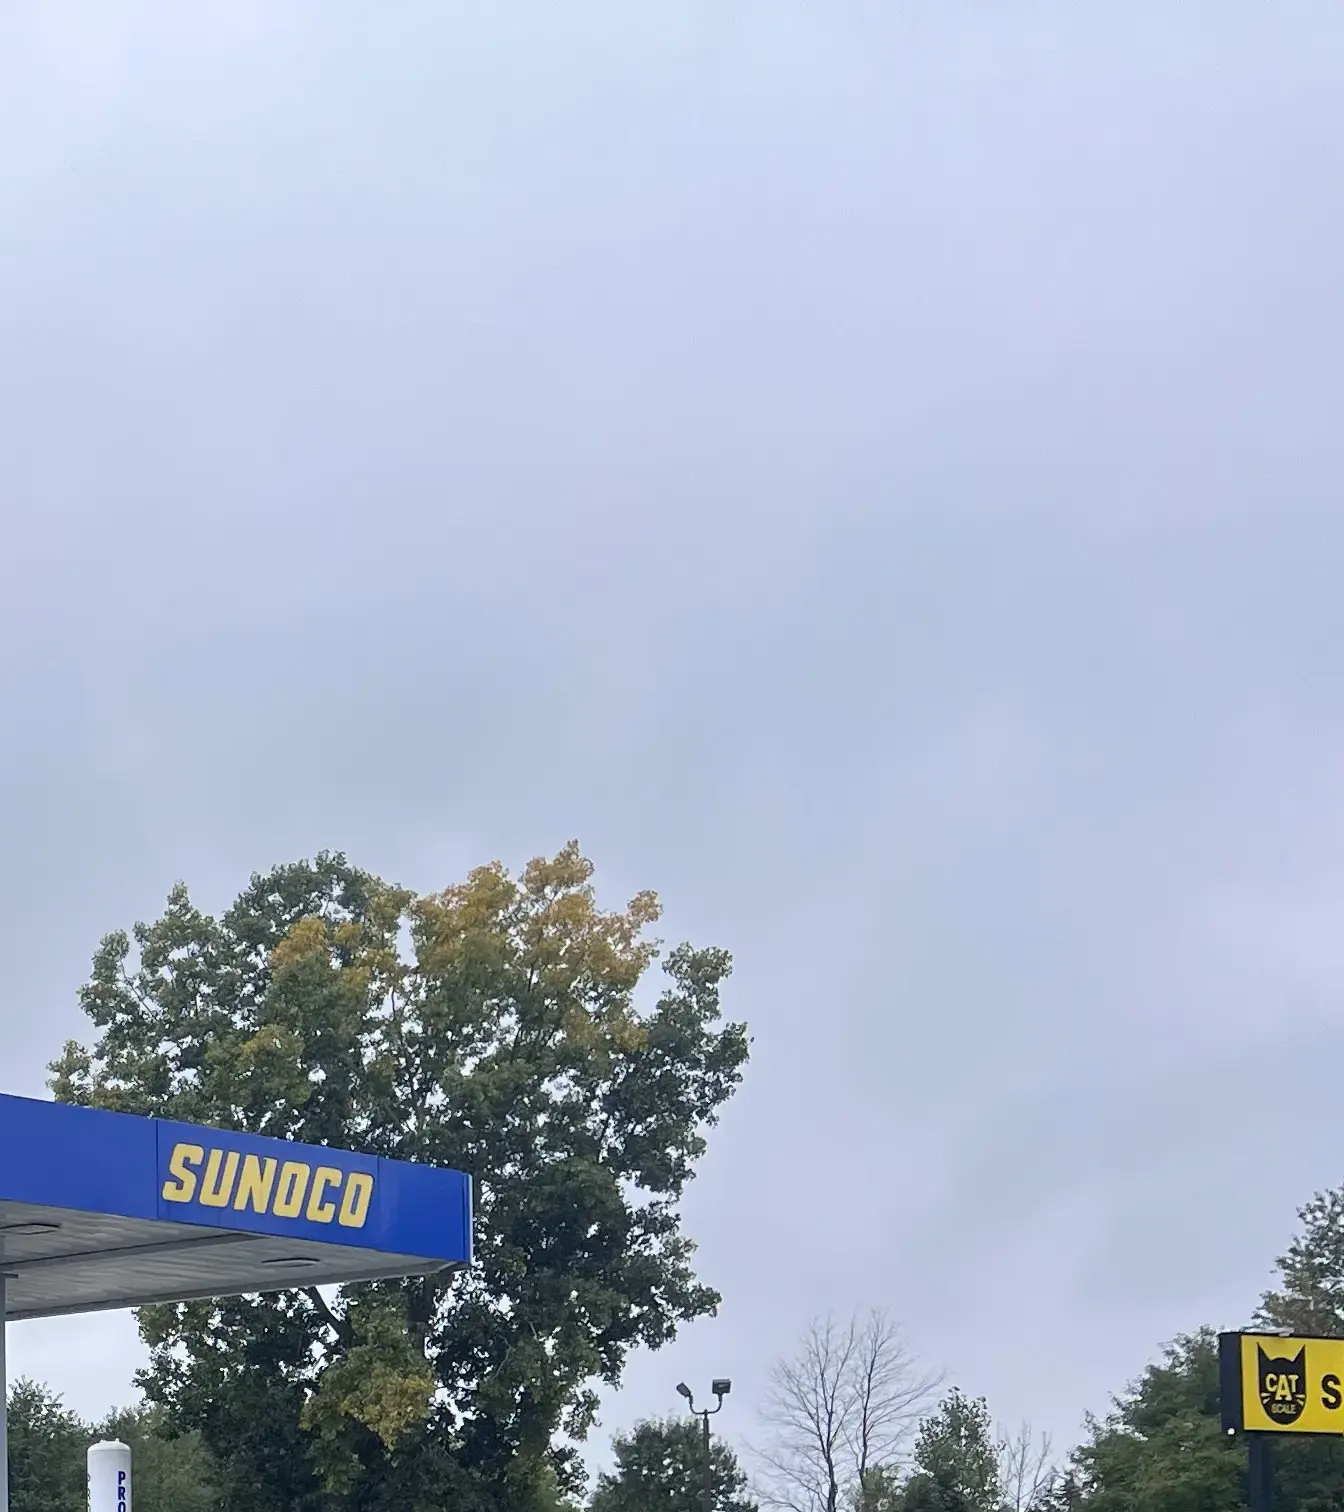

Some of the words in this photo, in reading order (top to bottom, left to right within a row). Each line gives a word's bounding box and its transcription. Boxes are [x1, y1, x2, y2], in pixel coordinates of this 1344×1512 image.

[162, 1143, 375, 1229] SUNOCO
[1265, 1373, 1299, 1401] CAT
[1271, 1403, 1296, 1414] SCALE
